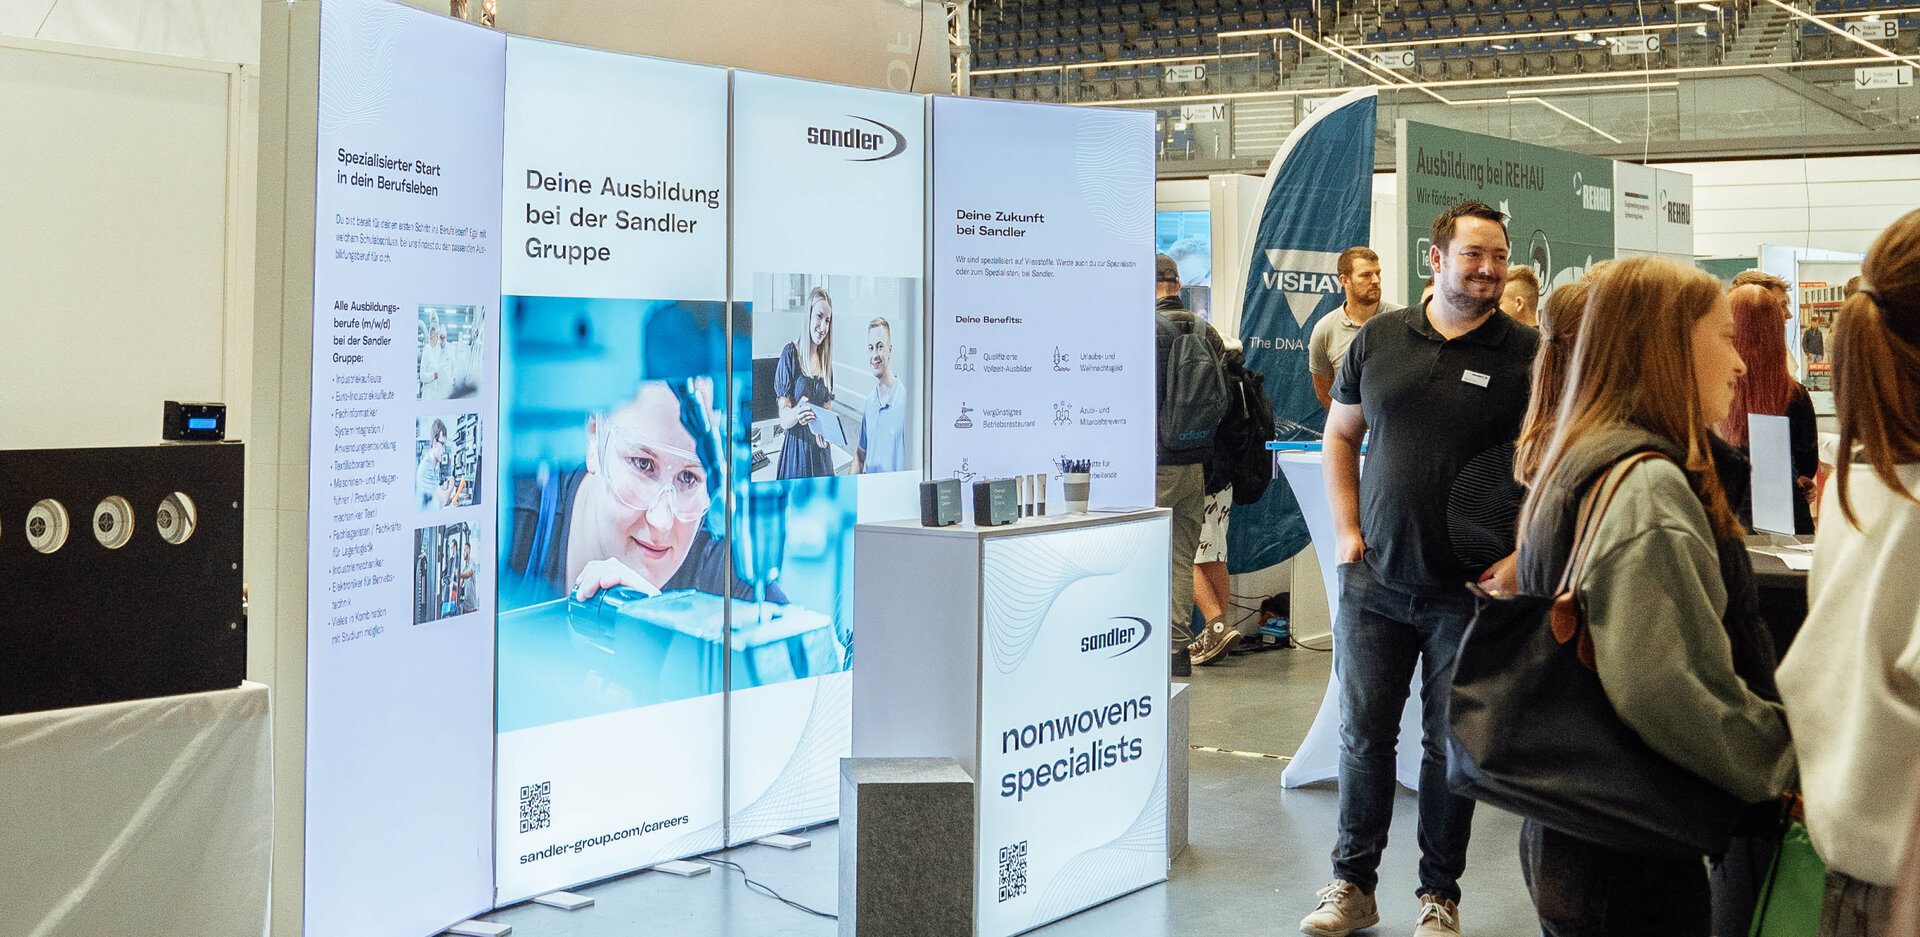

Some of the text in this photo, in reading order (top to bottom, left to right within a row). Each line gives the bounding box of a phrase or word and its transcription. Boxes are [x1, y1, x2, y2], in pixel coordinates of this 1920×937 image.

[1884, 22, 1897, 37] B
[1646, 36, 1659, 51] C
[1402, 52, 1414, 66] C
[1195, 66, 1205, 79] D
[1897, 69, 1908, 85] L
[1213, 105, 1224, 120] M
[807, 126, 884, 151] sandler
[337, 148, 441, 176] Spezialisierter Start
[1416, 146, 1544, 192] Ausbildung bei REHAU
[337, 170, 438, 196] in dein Berufsleben
[526, 170, 720, 209] Deine Ausbildung
[1417, 187, 1430, 204] Wir
[1432, 189, 1458, 206] fördern
[1583, 184, 1611, 212] REHAU
[526, 204, 697, 234] bei der Sandler
[956, 209, 1045, 223] Deine Zukunft
[1668, 201, 1690, 225] REHAU
[956, 224, 1026, 238] bei Sandler
[525, 237, 611, 265] Gruppe
[967, 256, 980, 264] sind
[980, 256, 1013, 265] spezialisiert
[1014, 257, 1024, 265] auf
[1056, 258, 1074, 266] Werde
[1075, 259, 1088, 267] auch
[1089, 259, 1097, 267] du
[956, 268, 970, 276] oder
[1031, 269, 1054, 278] Sandler.
[1263, 271, 1345, 294] VISHAY
[334, 300, 400, 314] Alle Ausbildungs-
[333, 317, 391, 330] berufe (m/w/d)
[955, 315, 1022, 324] Deine Benefits:
[333, 335, 392, 346] bei der Sandler
[1250, 337, 1304, 350] The DNA
[332, 352, 364, 365] Gruppe:
[983, 352, 1018, 362] Qualifizierte
[1079, 352, 1116, 361] Urlaubs- und
[983, 365, 1032, 373] Vollzeit-Ausbilder
[1079, 364, 1123, 374] Weihnachtsgeld
[983, 408, 1022, 418] Vergünstigtes
[1098, 406, 1110, 414] und
[983, 420, 1036, 429] Betriebsrestaurant
[1079, 417, 1127, 426] Mitarbeiterevents
[1080, 627, 1135, 653] sandler
[1002, 695, 1152, 754] nonwovens
[1001, 735, 1143, 802] specialists
[520, 814, 689, 865] sandler-group.com/careers
